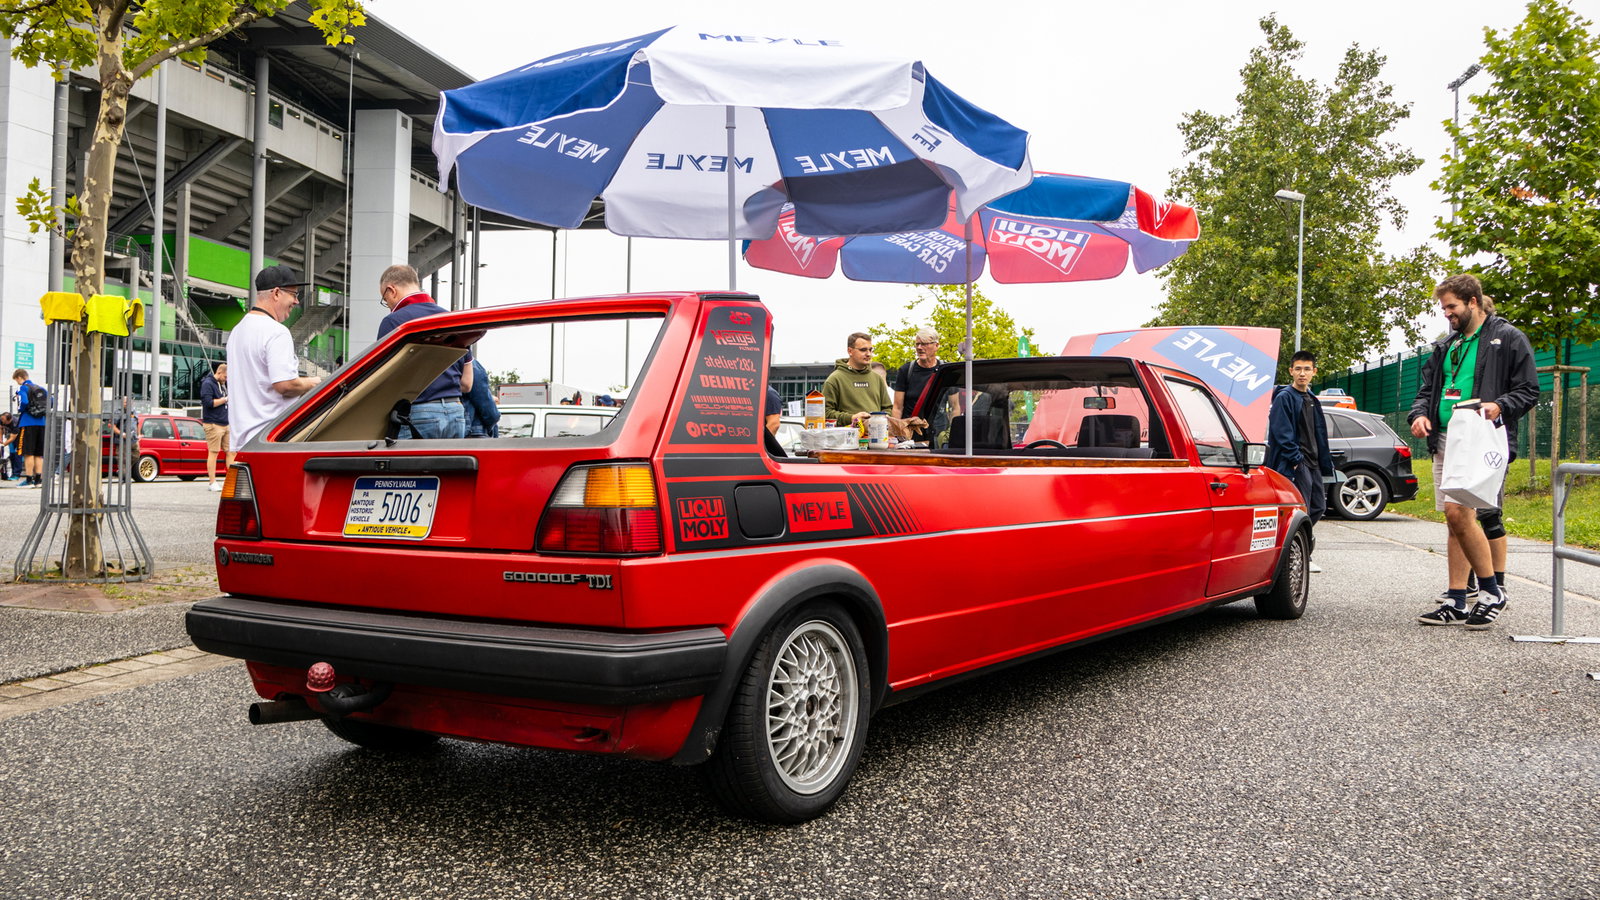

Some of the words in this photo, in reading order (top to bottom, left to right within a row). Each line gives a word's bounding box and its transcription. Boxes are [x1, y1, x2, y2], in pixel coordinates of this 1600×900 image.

[699, 33, 845, 47] MEYLE
[1172, 330, 1271, 391] MEYLE
[699, 374, 750, 391] DELINTE
[700, 424, 727, 437] FCP
[728, 426, 751, 438] EURO
[374, 480, 417, 488] PENNSYLVANIA
[354, 499, 375, 507] ANTIQUE
[378, 491, 423, 524] 5D06
[680, 499, 725, 519] LIQUI
[792, 501, 847, 523] MEYLE
[361, 526, 384, 534] ANTIQUE
[385, 526, 408, 534] VEHICLE
[683, 519, 725, 539] MOLY
[503, 571, 581, 583] GOOOOLF
[586, 574, 612, 588] TDI
